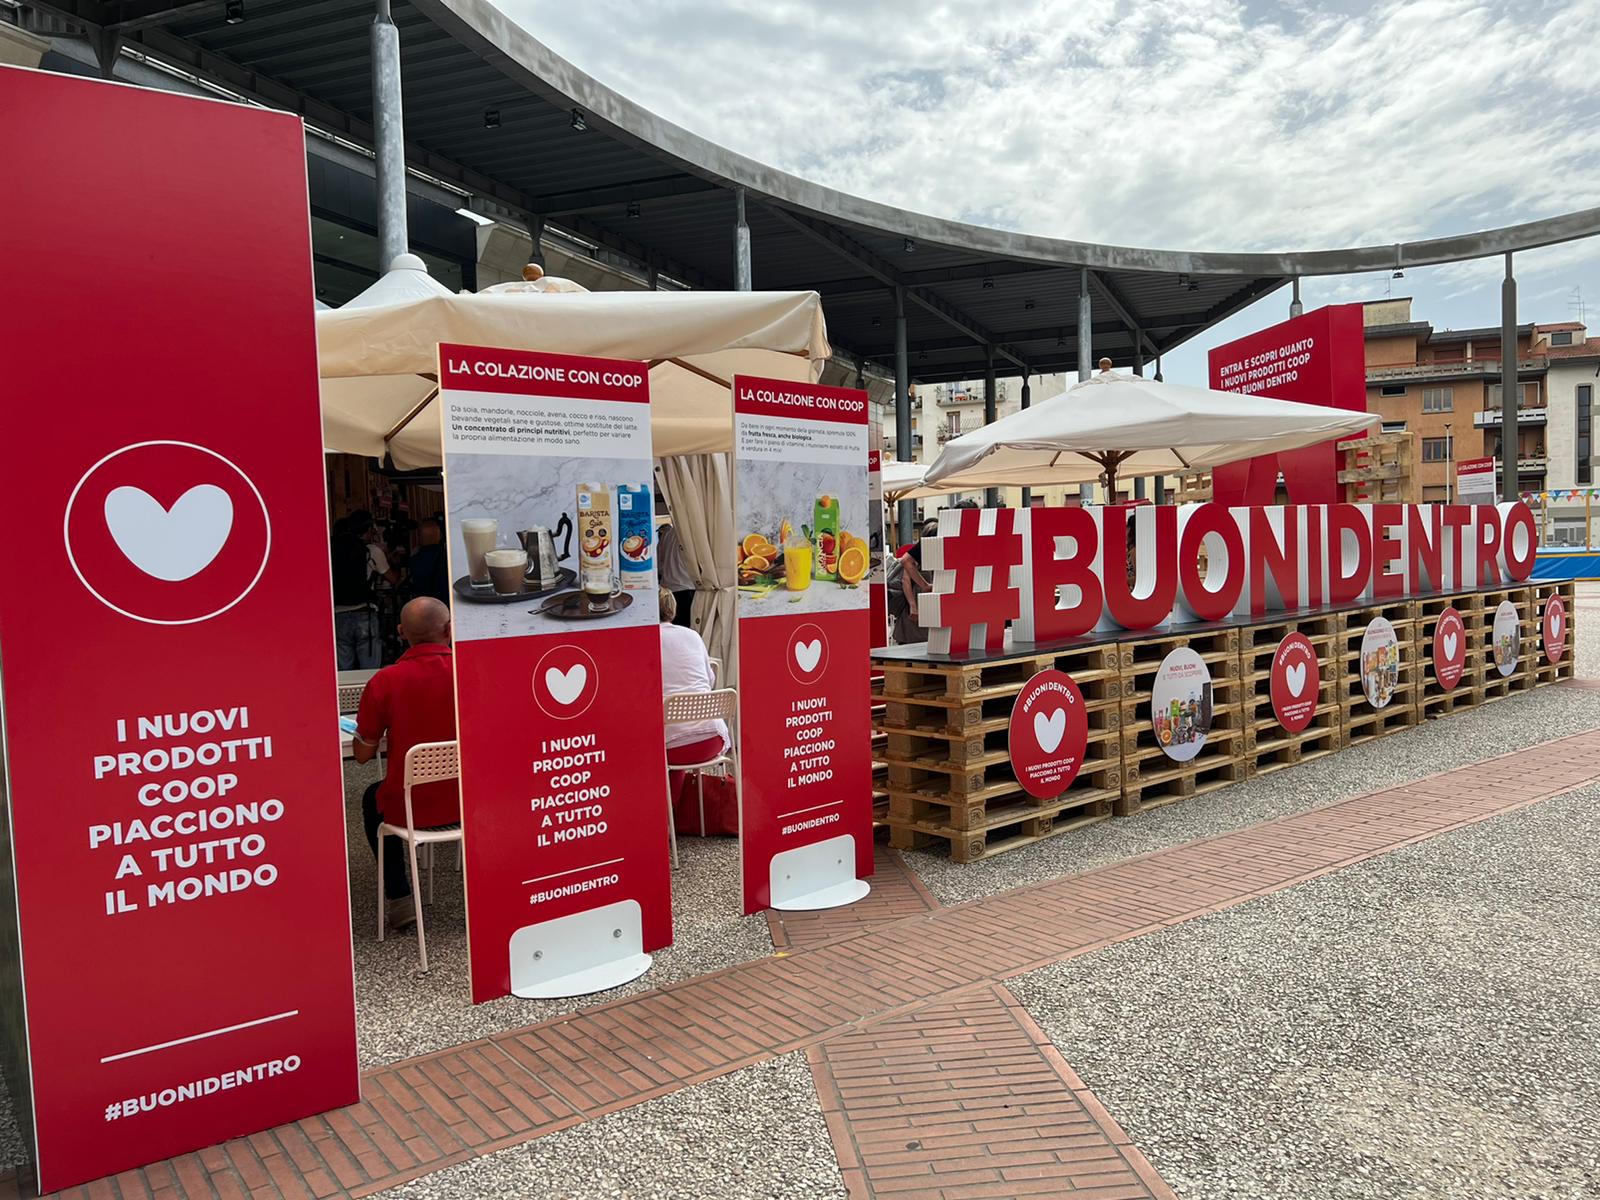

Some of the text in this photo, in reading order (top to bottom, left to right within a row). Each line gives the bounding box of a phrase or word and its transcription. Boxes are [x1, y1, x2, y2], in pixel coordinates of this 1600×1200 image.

[1221, 338, 1313, 376] ENTRA E SCOPRI QUANTO
[448, 360, 642, 388] LA COLAZIONE CON COOP
[1221, 353, 1310, 388] I NUOVI PRODOTTI COOP
[1242, 380, 1265, 394] BUONI
[1267, 371, 1297, 388] DENTRO
[481, 407, 515, 416] mandorle,
[740, 388, 864, 412] LA COLAZIONE CON COOP
[919, 500, 1537, 654] #BUONIDENTRO
[792, 697, 826, 712] I NUOVI
[1023, 682, 1075, 713] #BUONIDENTRO
[117, 708, 249, 741] I NUOVI
[786, 711, 832, 728] PRODOTTI
[542, 734, 596, 754] I NUOVI
[797, 728, 822, 741] COOP
[94, 736, 272, 779] PRODOTTI
[784, 740, 835, 758] PIACCIONO
[533, 751, 605, 773] PRODOTTI
[791, 756, 830, 773] A TUTTO
[1030, 769, 1052, 778] PIACCIONO
[551, 771, 591, 788] COOP
[788, 769, 832, 788] IL MONDO
[138, 775, 236, 807] COOP
[531, 785, 610, 811] PIACCIONO
[90, 799, 285, 849] PIACCIONO
[542, 805, 602, 828] A TUTTO
[782, 813, 840, 835] #BUONIDENTRO
[537, 822, 607, 847] IL MONDO
[116, 834, 265, 880] A TUTTO
[107, 865, 278, 916] IL MONDO
[530, 874, 619, 904] #BUONIDENTRO
[105, 1056, 300, 1123] #BUONIDENTRO
